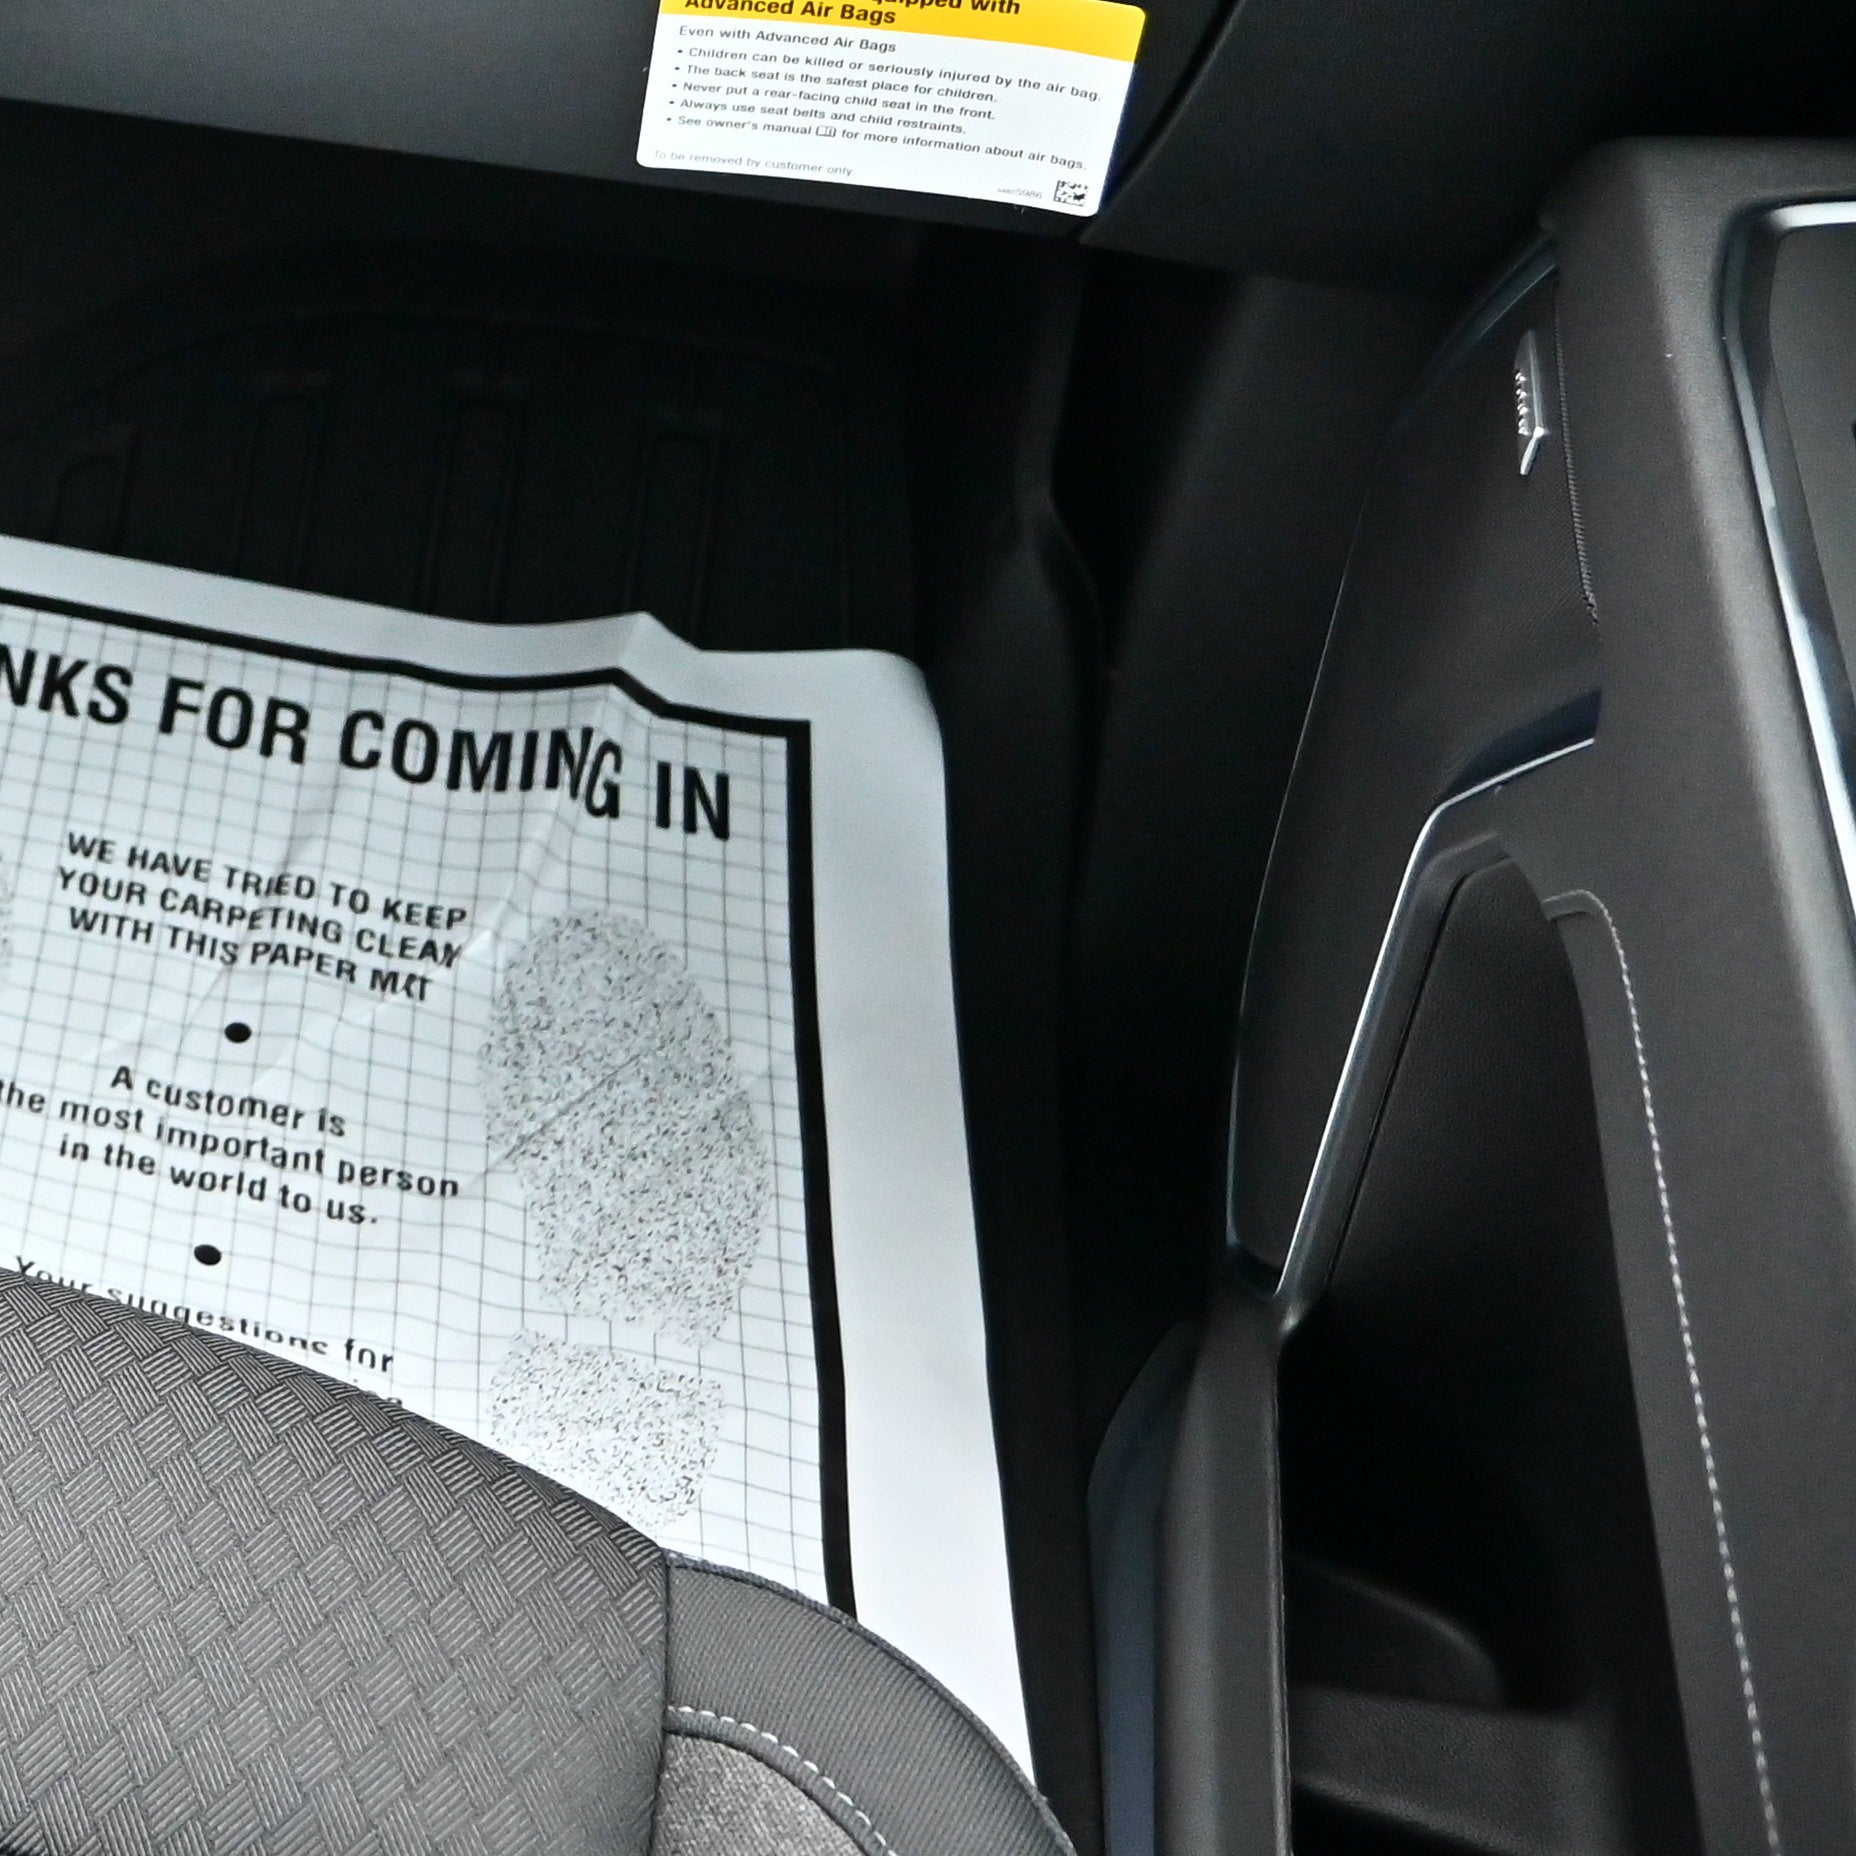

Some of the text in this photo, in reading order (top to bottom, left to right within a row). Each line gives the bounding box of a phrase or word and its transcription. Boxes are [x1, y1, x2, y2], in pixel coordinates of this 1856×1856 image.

[679, 25, 897, 53] Even with Advanced Air Bags
[800, 1, 833, 18] Air
[839, 4, 896, 26] Bags
[683, 82, 996, 120] Never put a rear-facing child seat in the front.
[686, 64, 998, 102] The back seat is the safest place for children.
[688, 47, 1102, 103] Children can be killed or seriously injured by the air bag.
[678, 116, 1086, 170] See owner's manual for more information about air bags.
[680, 98, 966, 134] Always use seat belts and child restraints.
[654, 150, 853, 177] To be removed by customer only
[160, 677, 310, 766] FOR
[339, 710, 623, 819] COMING
[655, 761, 732, 841] IN
[57, 866, 147, 906] YOUR
[160, 887, 343, 943] CARPETING
[67, 832, 467, 930] WE HAVE TRIED TO KEEP
[69, 906, 154, 944] WITH
[168, 926, 238, 965] THIS
[251, 942, 357, 983] PAPER
[111, 1065, 347, 1137] A customer is
[59, 1099, 144, 1133] most
[155, 1117, 326, 1174] important
[337, 1156, 460, 1199] person
[59, 1133, 379, 1225] in the world to us.
[343, 1338, 395, 1373] for
